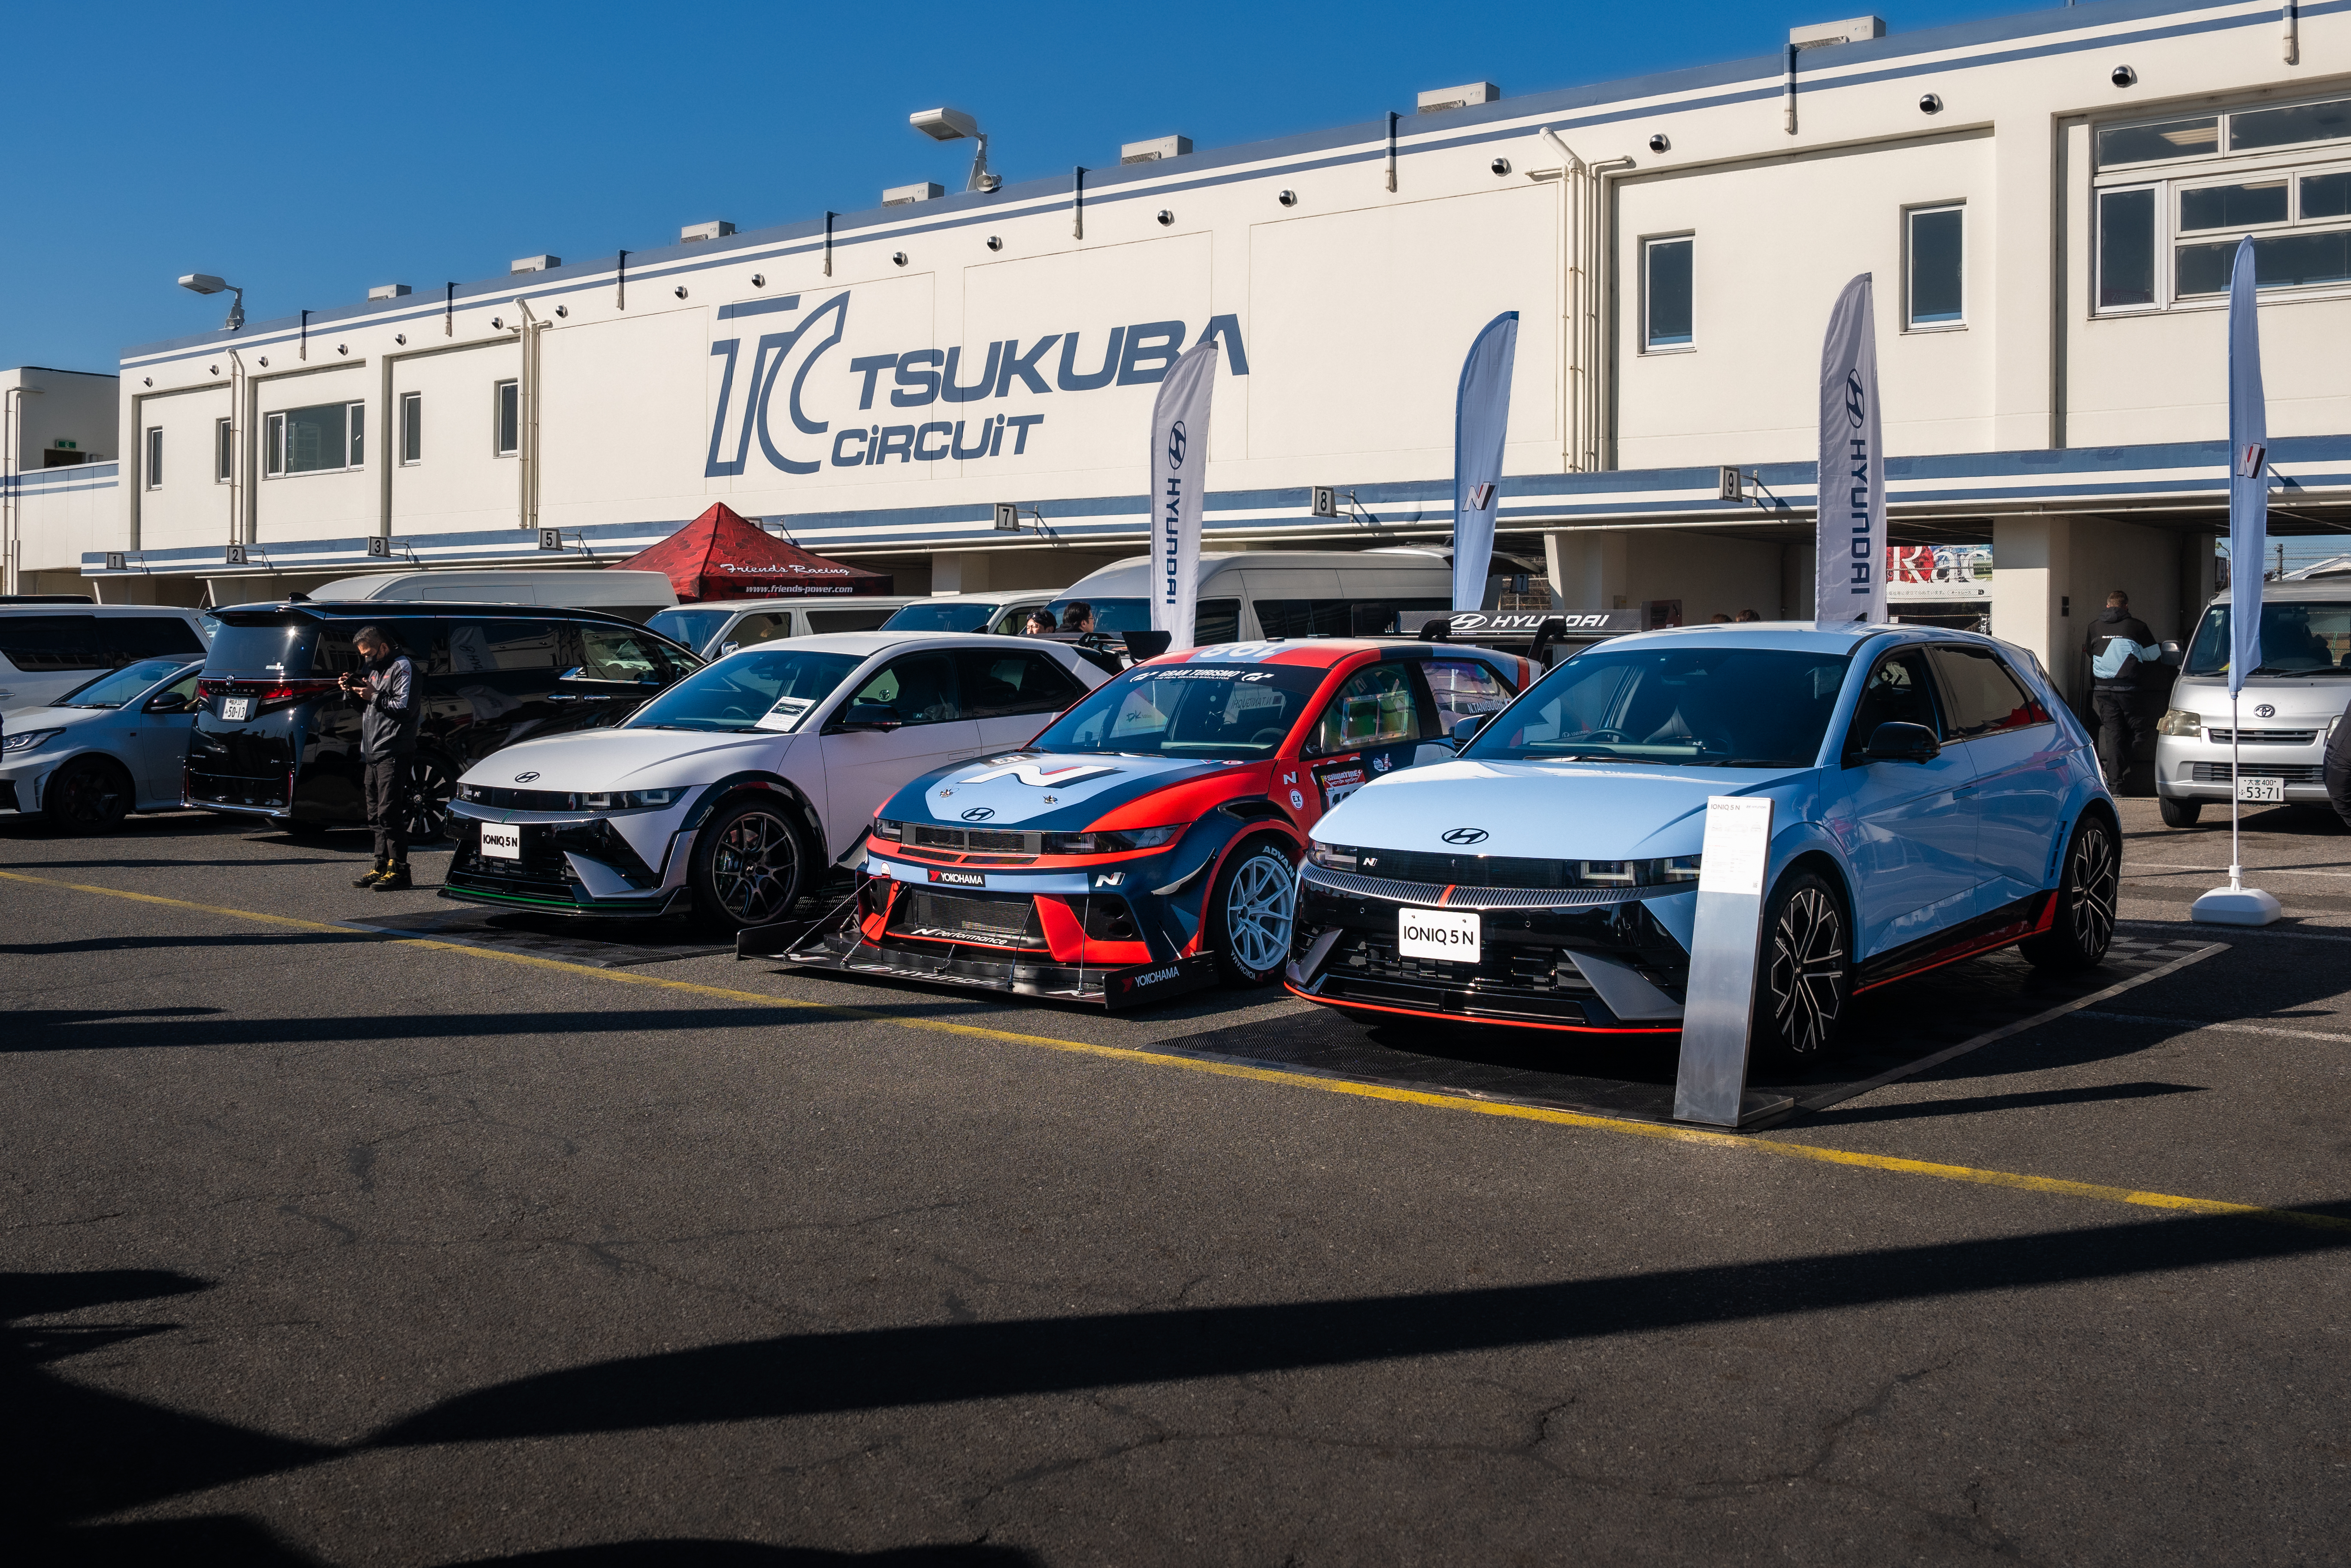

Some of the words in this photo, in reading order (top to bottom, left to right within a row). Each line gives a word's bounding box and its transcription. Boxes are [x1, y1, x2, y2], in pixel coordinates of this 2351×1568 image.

[850, 314, 1249, 410] TSUKUBA
[1728, 472, 1734, 495] 9
[1320, 491, 1327, 511] 8
[1002, 508, 1010, 526] 7
[1850, 439, 1870, 594] HYUNDAI
[374, 540, 381, 553] 3
[546, 532, 552, 547] 5
[1166, 478, 1181, 604] HYUNDAI
[112, 557, 117, 567] 1
[232, 549, 239, 561] 2
[720, 563, 789, 574] Friends
[789, 565, 850, 575] Racing
[746, 585, 853, 594] www.friends-power.com
[1519, 575, 1525, 590] 7
[1490, 615, 1610, 627] HYUDAI
[1467, 700, 1504, 714] N.TANIGUCHI
[1327, 770, 1359, 781] SHIBATIRE
[2247, 787, 2279, 799] 53-71
[483, 834, 505, 848] IONIQ
[505, 837, 511, 846] 5
[512, 837, 517, 847] N
[1262, 846, 1295, 879] ADVAN
[940, 872, 983, 885] YOKOHAMA
[938, 930, 1008, 946] Performance
[1404, 926, 1446, 946] IONIQ
[1450, 930, 1459, 944] 5
[1462, 931, 1473, 945] N
[1231, 949, 1256, 980] YOKOHAMA
[891, 969, 1007, 987] HYUNDAI
[1135, 966, 1180, 987] YOKOHAMA
